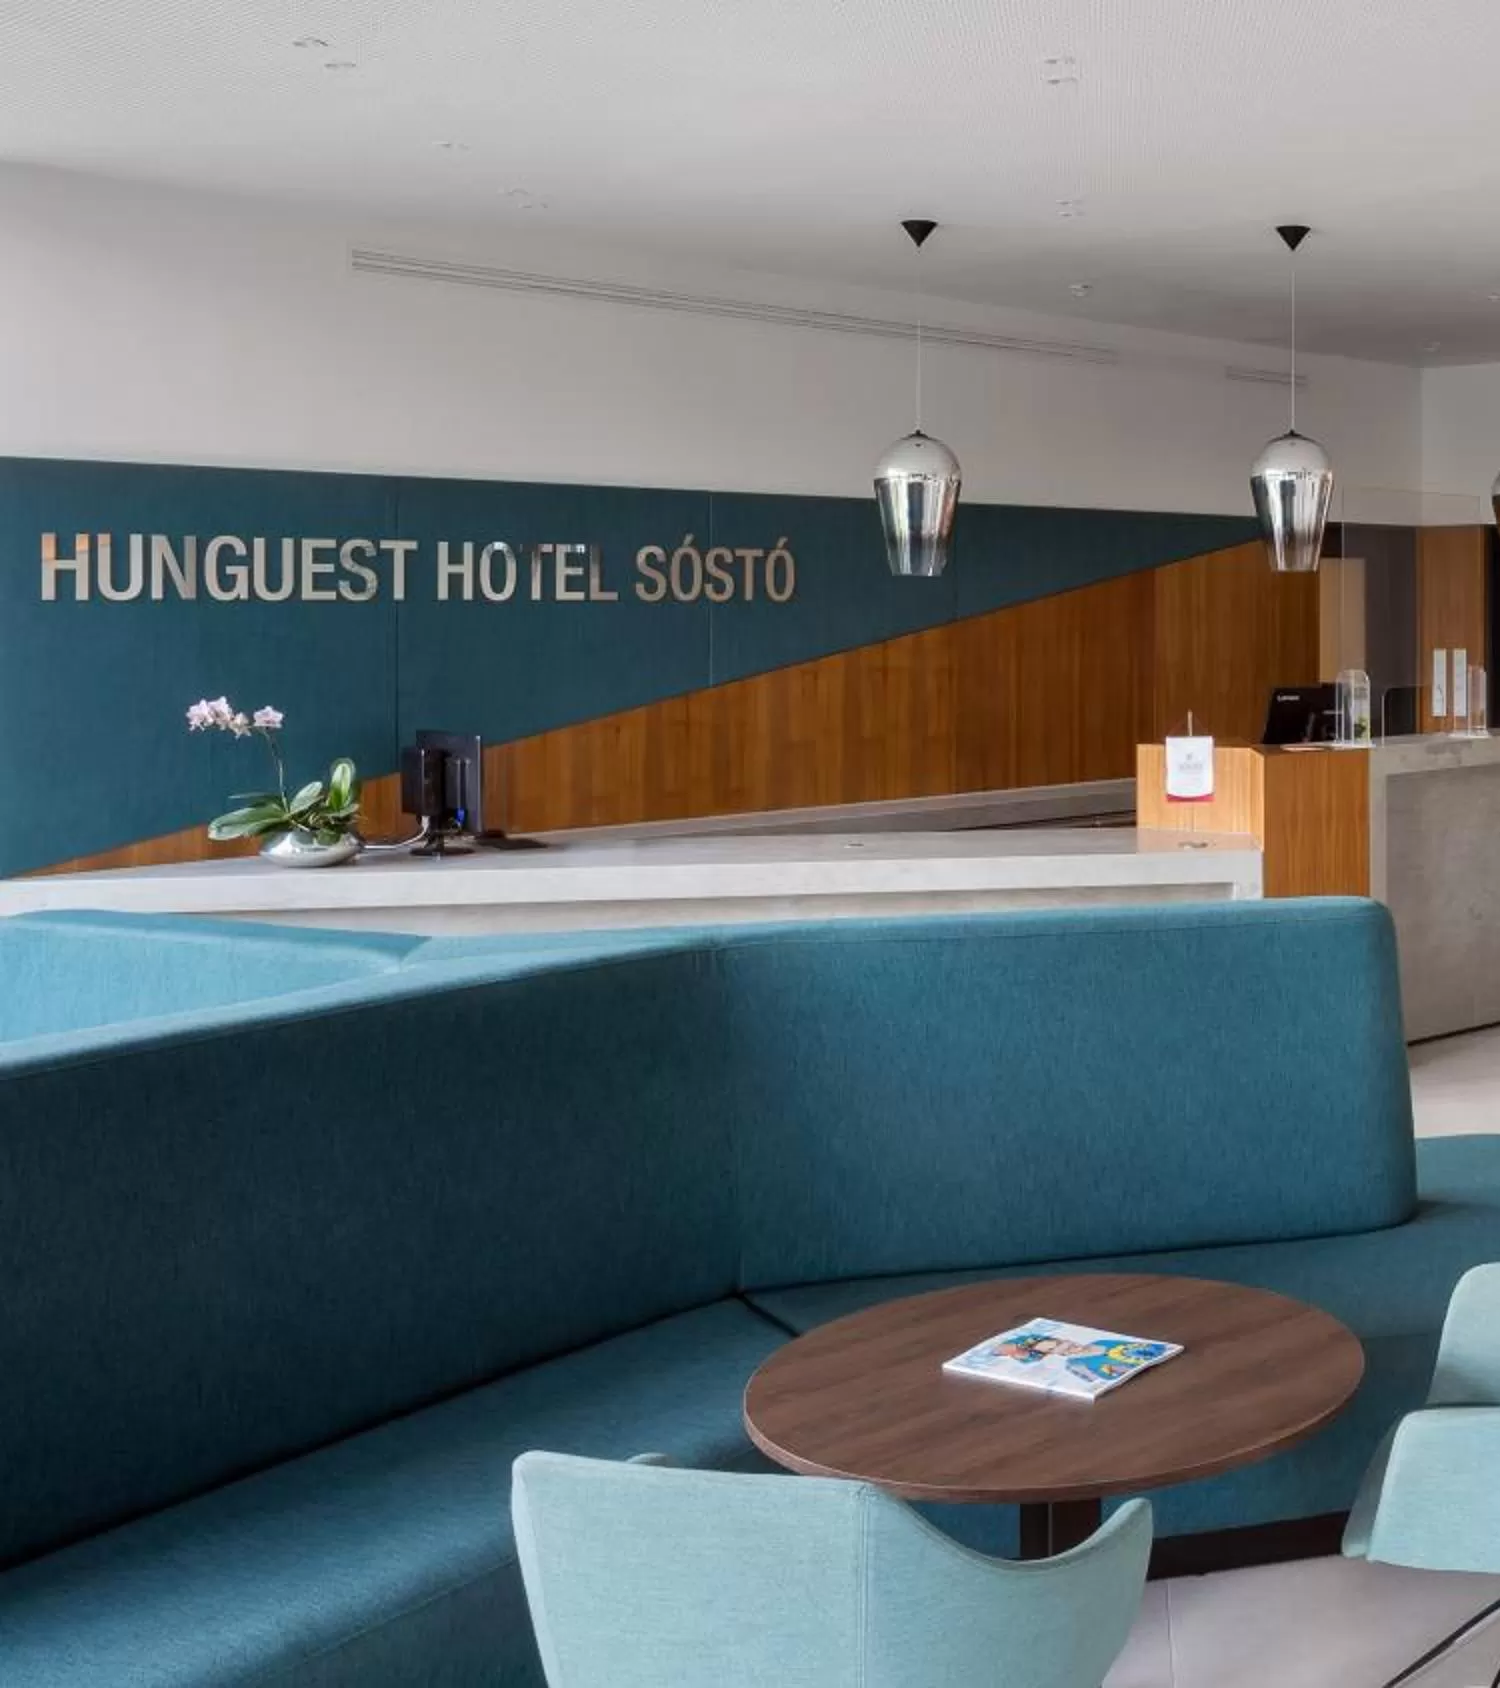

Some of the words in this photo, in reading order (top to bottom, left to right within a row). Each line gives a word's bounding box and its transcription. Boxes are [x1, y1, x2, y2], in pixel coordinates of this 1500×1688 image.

[41, 532, 418, 601] HUNGUEST
[436, 540, 619, 601] HOTEL
[634, 533, 796, 601] SÓSTÓ
